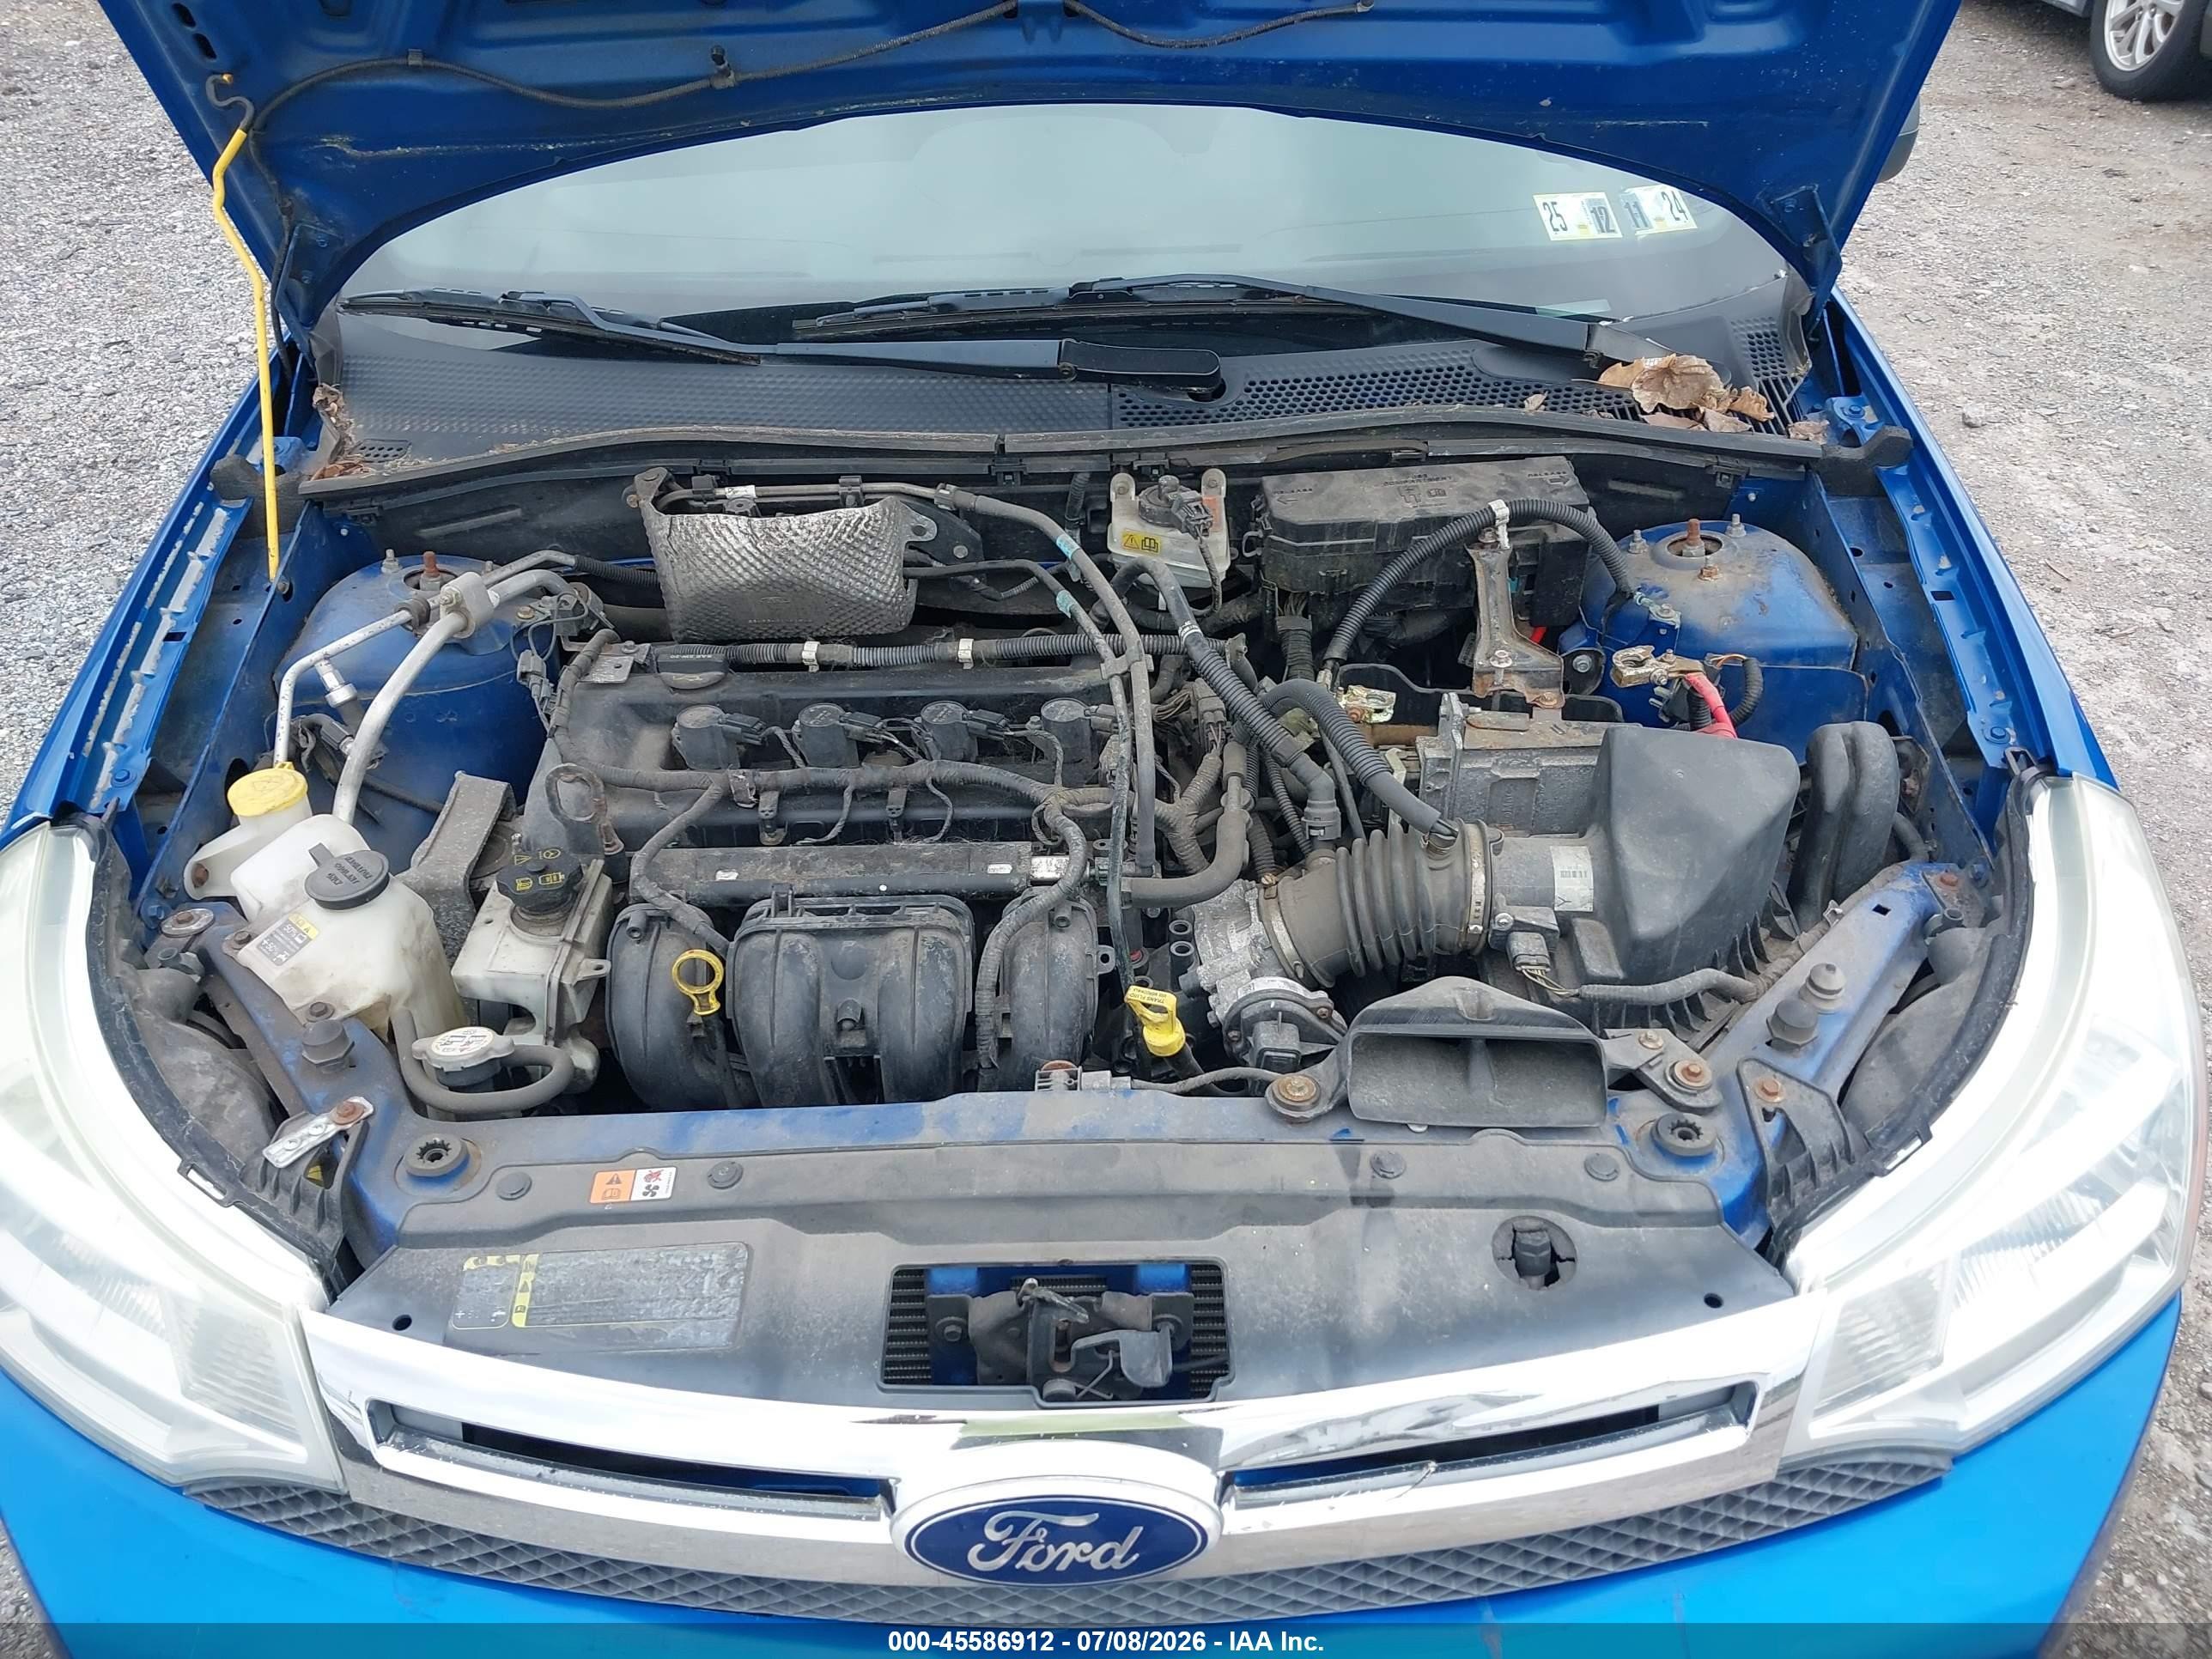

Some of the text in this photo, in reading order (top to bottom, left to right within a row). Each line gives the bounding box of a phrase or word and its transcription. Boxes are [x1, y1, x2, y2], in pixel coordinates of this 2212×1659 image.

[1542, 201, 1615, 234] 25 12
[1624, 190, 1688, 229] 11 24
[967, 1510, 1143, 1572] Ford
